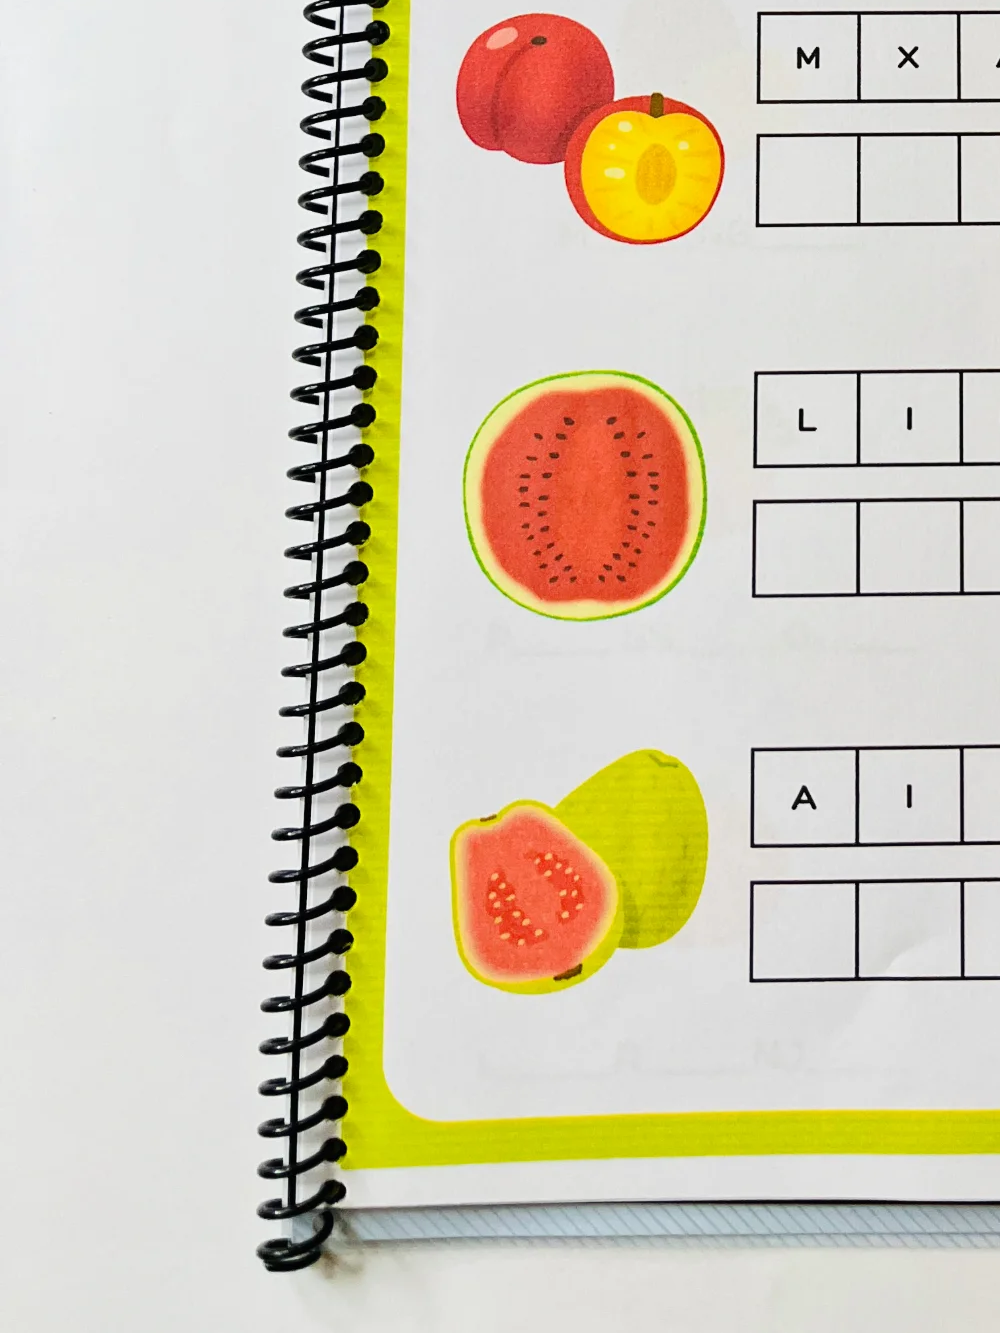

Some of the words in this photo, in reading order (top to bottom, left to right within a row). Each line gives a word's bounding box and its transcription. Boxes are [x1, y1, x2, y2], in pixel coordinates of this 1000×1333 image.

[796, 46, 821, 70] M
[897, 45, 920, 69] X
[798, 407, 818, 433] L
[790, 784, 818, 811] A
